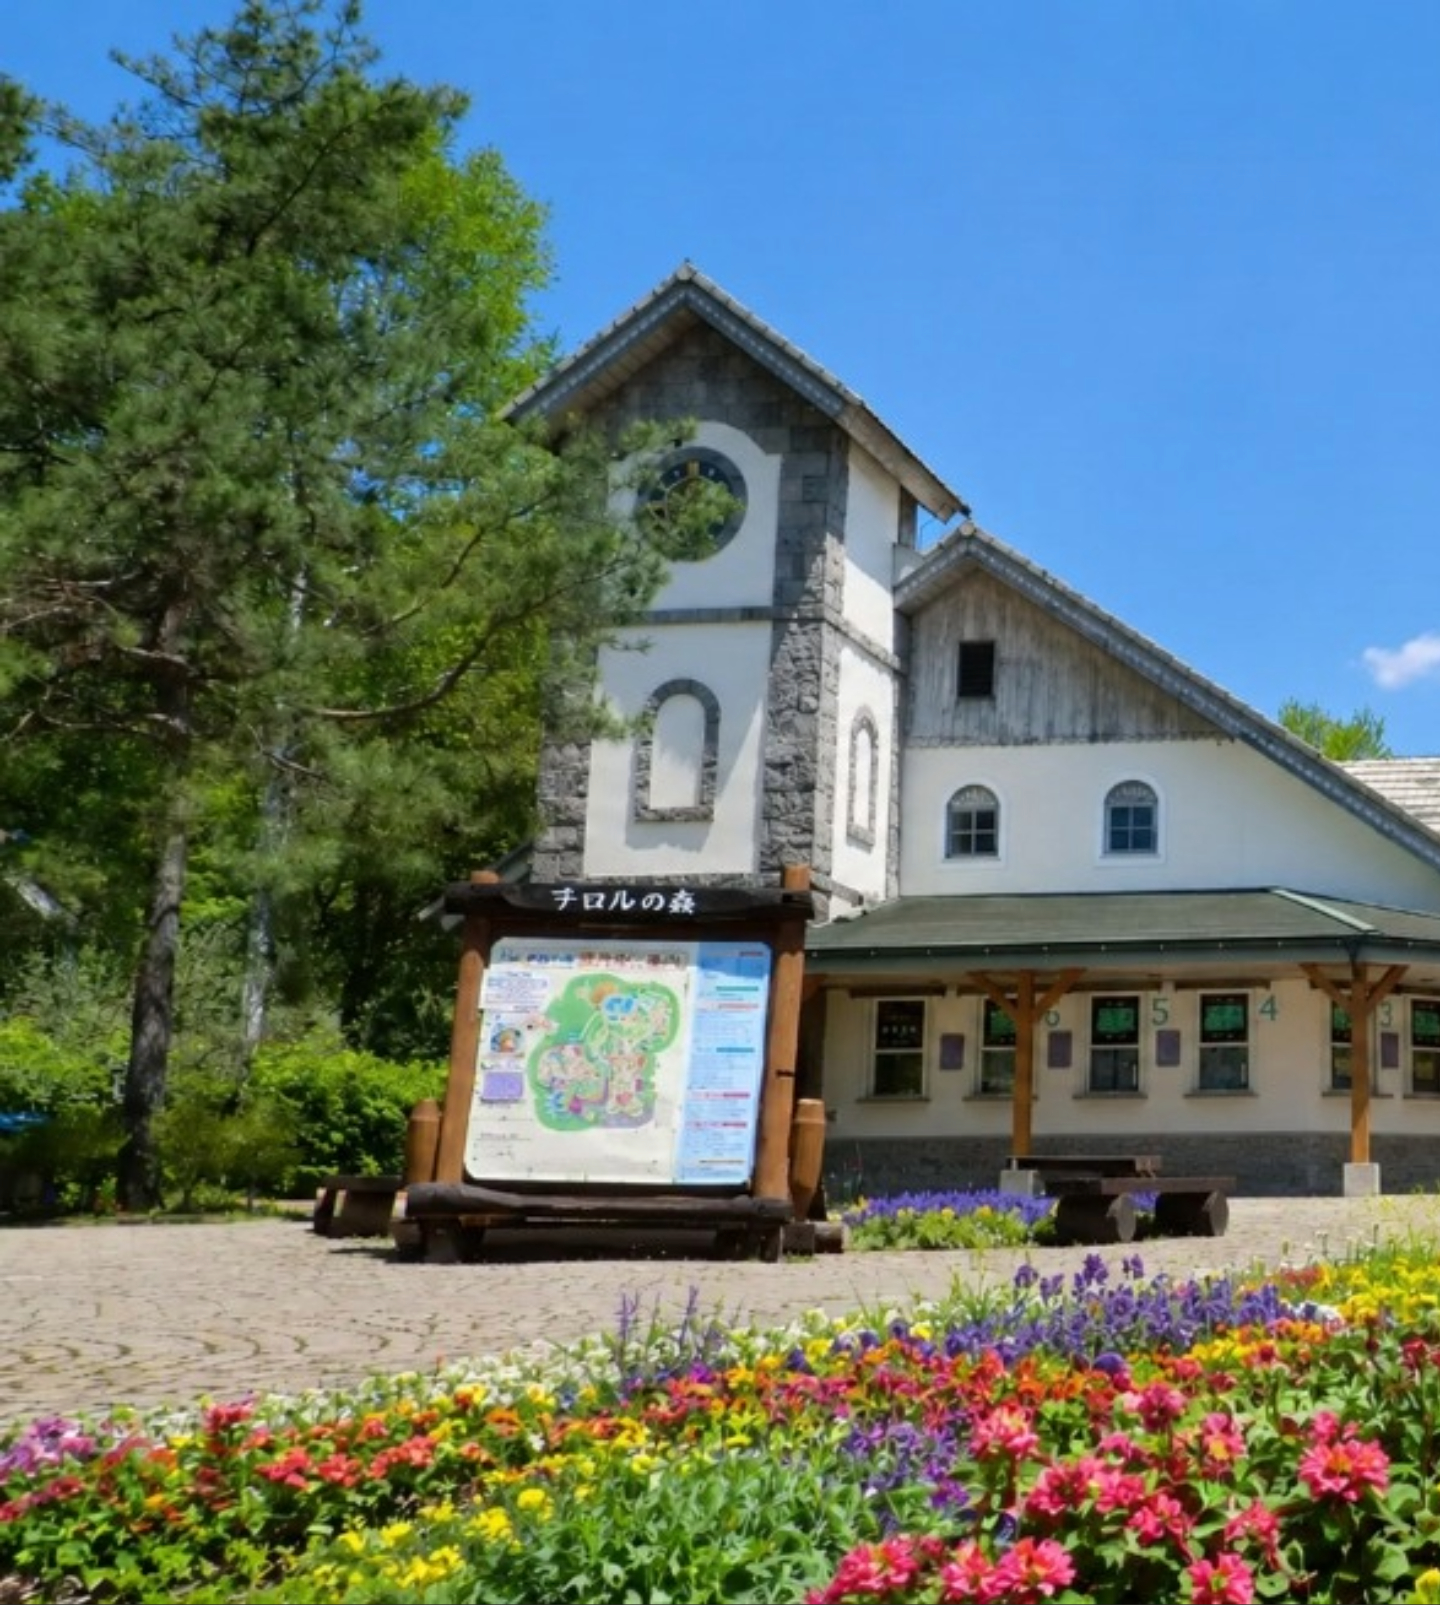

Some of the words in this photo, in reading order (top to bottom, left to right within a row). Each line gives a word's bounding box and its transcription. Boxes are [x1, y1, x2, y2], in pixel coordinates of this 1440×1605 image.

[551, 887, 696, 915] チロルの森
[1152, 998, 1169, 1026] 5
[1260, 995, 1277, 1021] 4
[1379, 1001, 1392, 1028] 3
